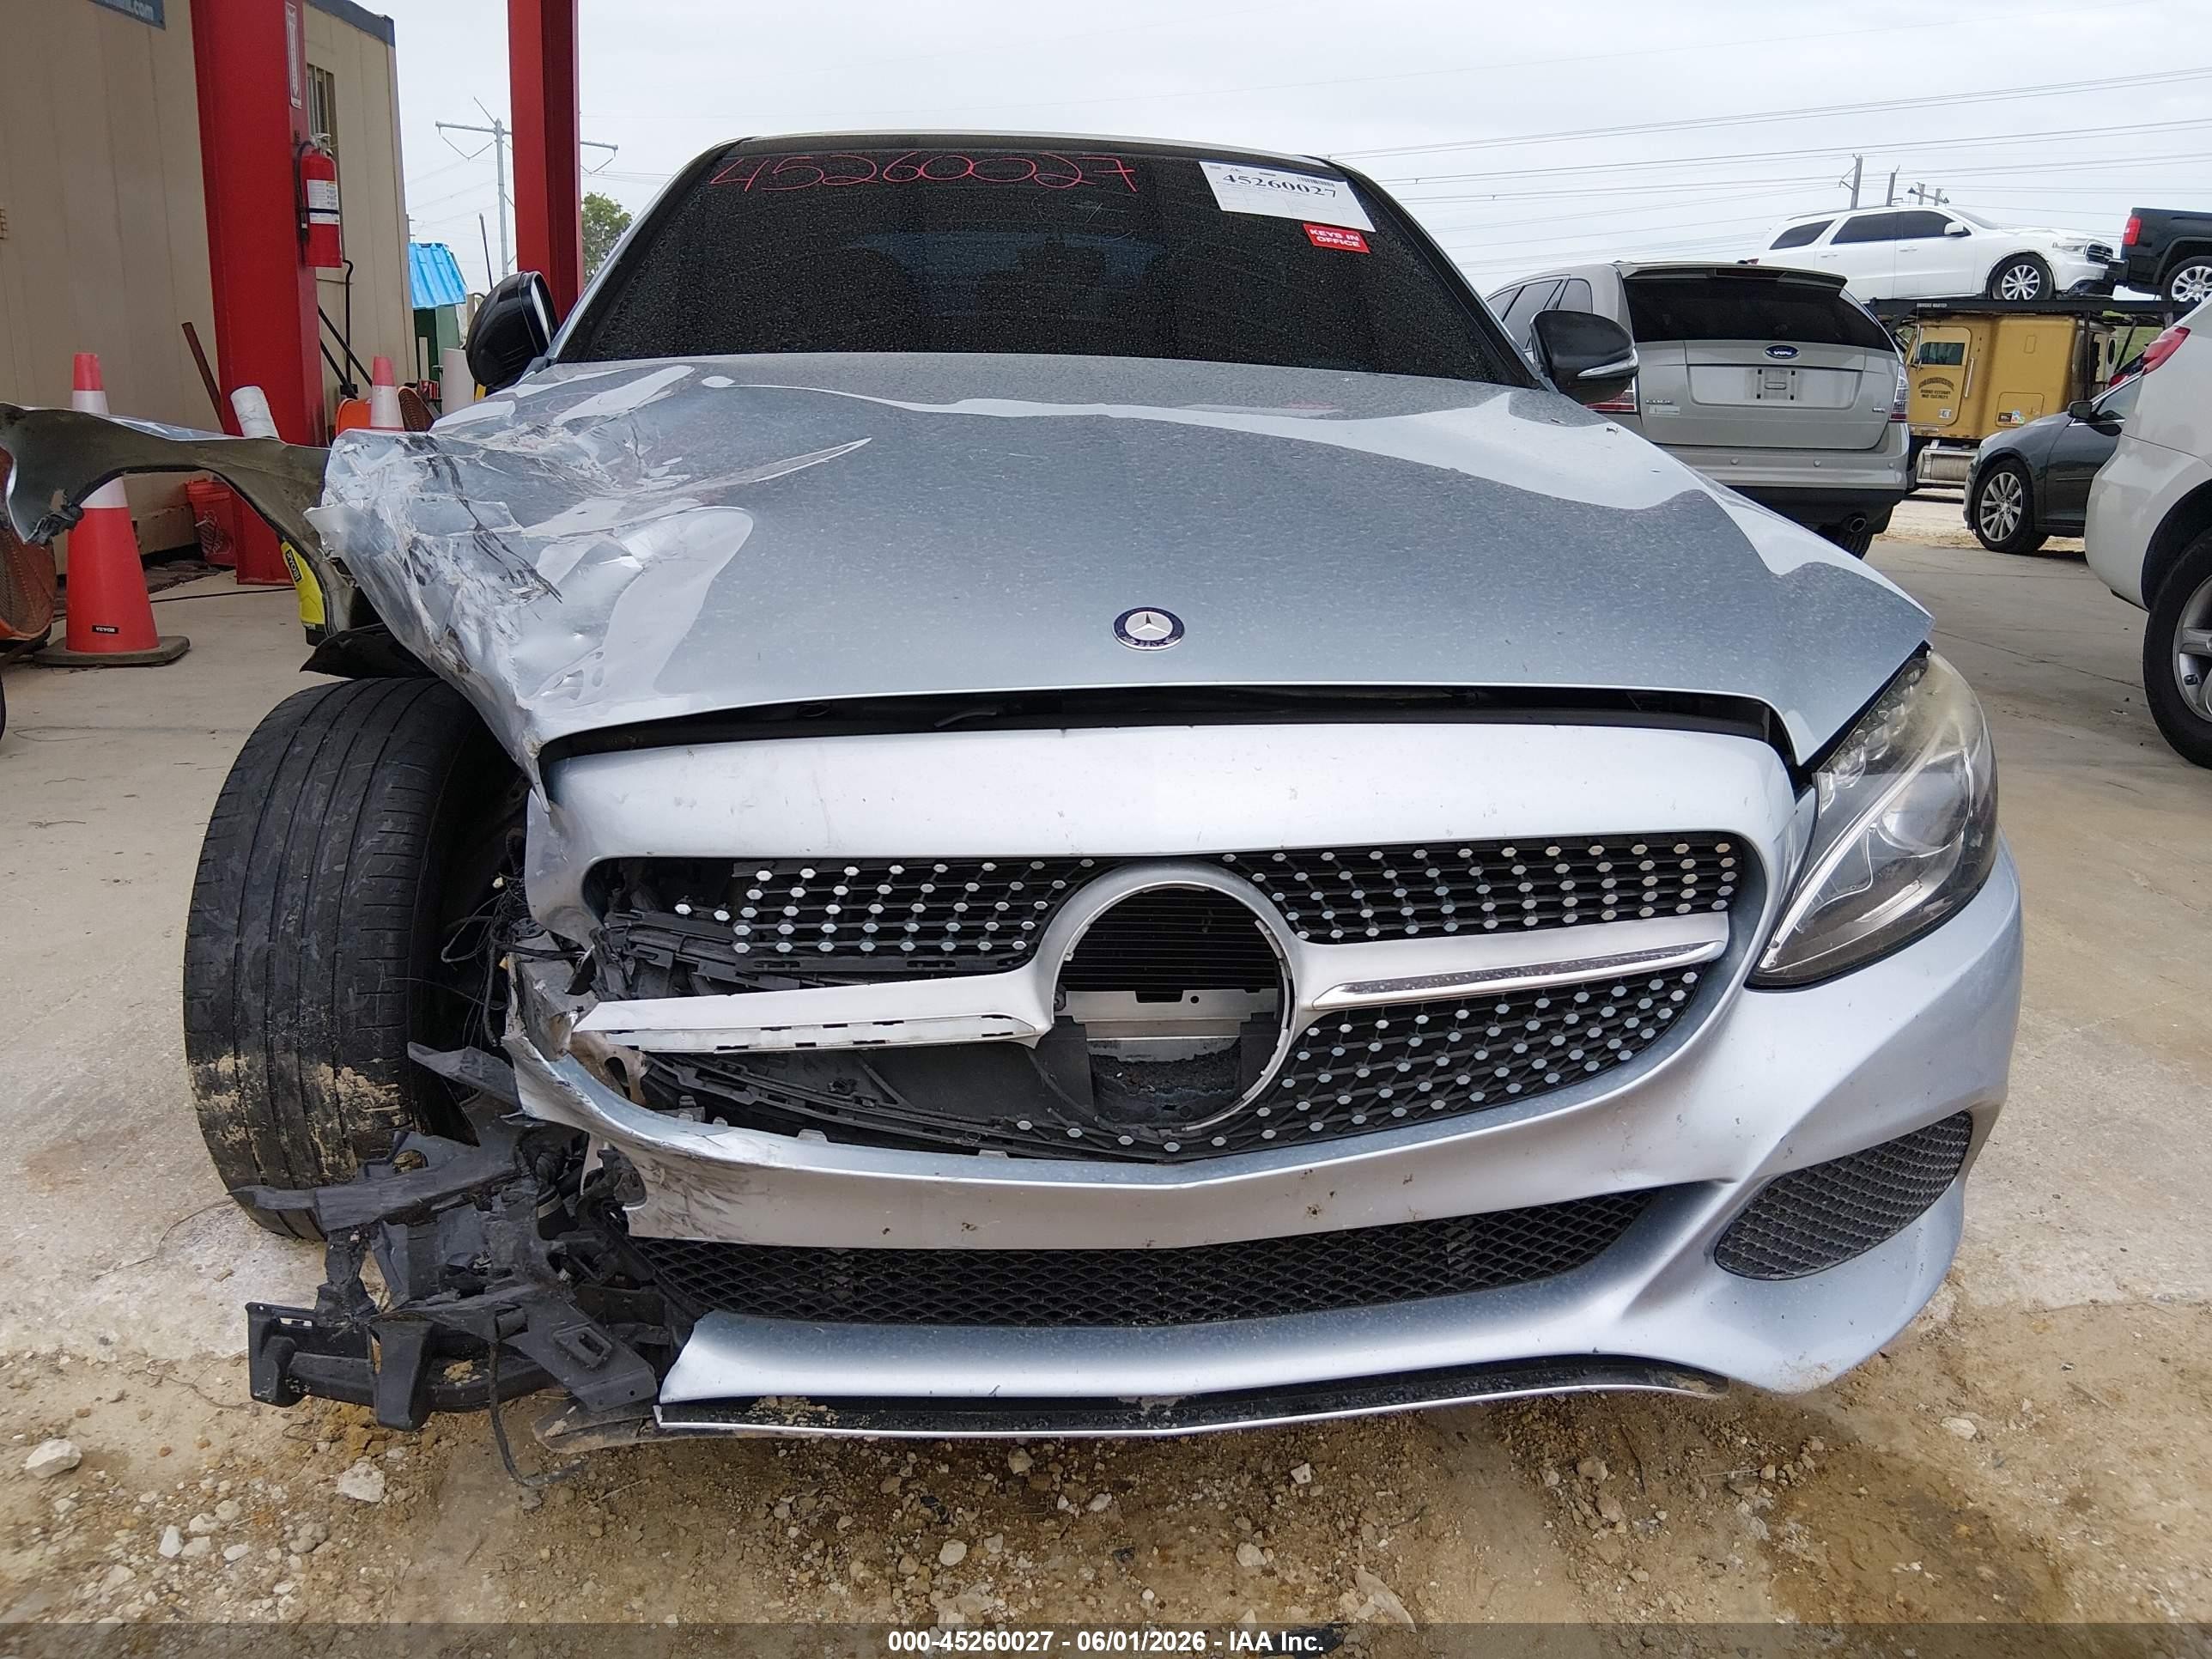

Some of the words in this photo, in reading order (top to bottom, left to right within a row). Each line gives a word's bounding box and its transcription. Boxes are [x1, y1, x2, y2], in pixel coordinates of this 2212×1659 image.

[709, 151, 1137, 193] 45260027
[1222, 173, 1337, 198] 45260027
[1309, 228, 1344, 239] KEYS
[1346, 234, 1360, 242] IN
[1316, 235, 1361, 248] OFFICE
[285, 550, 301, 582] RYOBI
